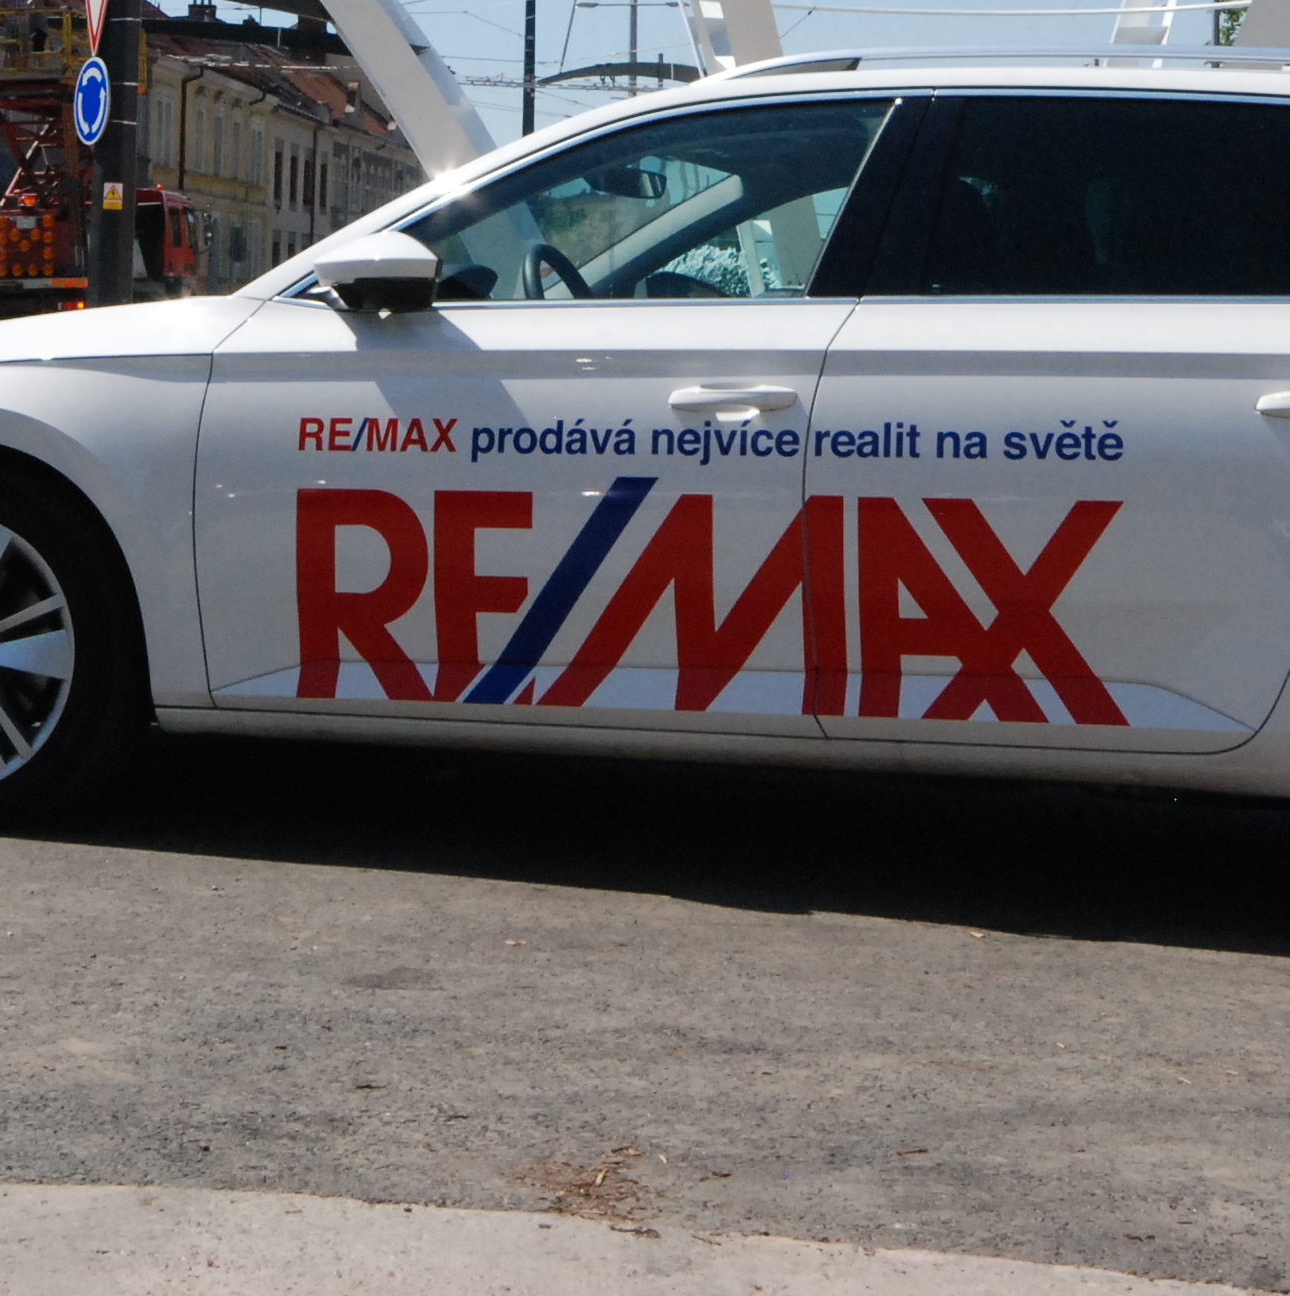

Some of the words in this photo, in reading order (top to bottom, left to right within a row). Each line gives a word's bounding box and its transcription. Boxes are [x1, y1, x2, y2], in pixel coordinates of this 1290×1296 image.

[298, 418, 459, 453] RE/MAX
[470, 418, 636, 463] prodává
[651, 418, 801, 466] nejvíce
[813, 422, 921, 459] realit
[935, 431, 988, 460] na
[1003, 419, 1124, 462] světě
[295, 476, 1131, 726] RE/MAX
